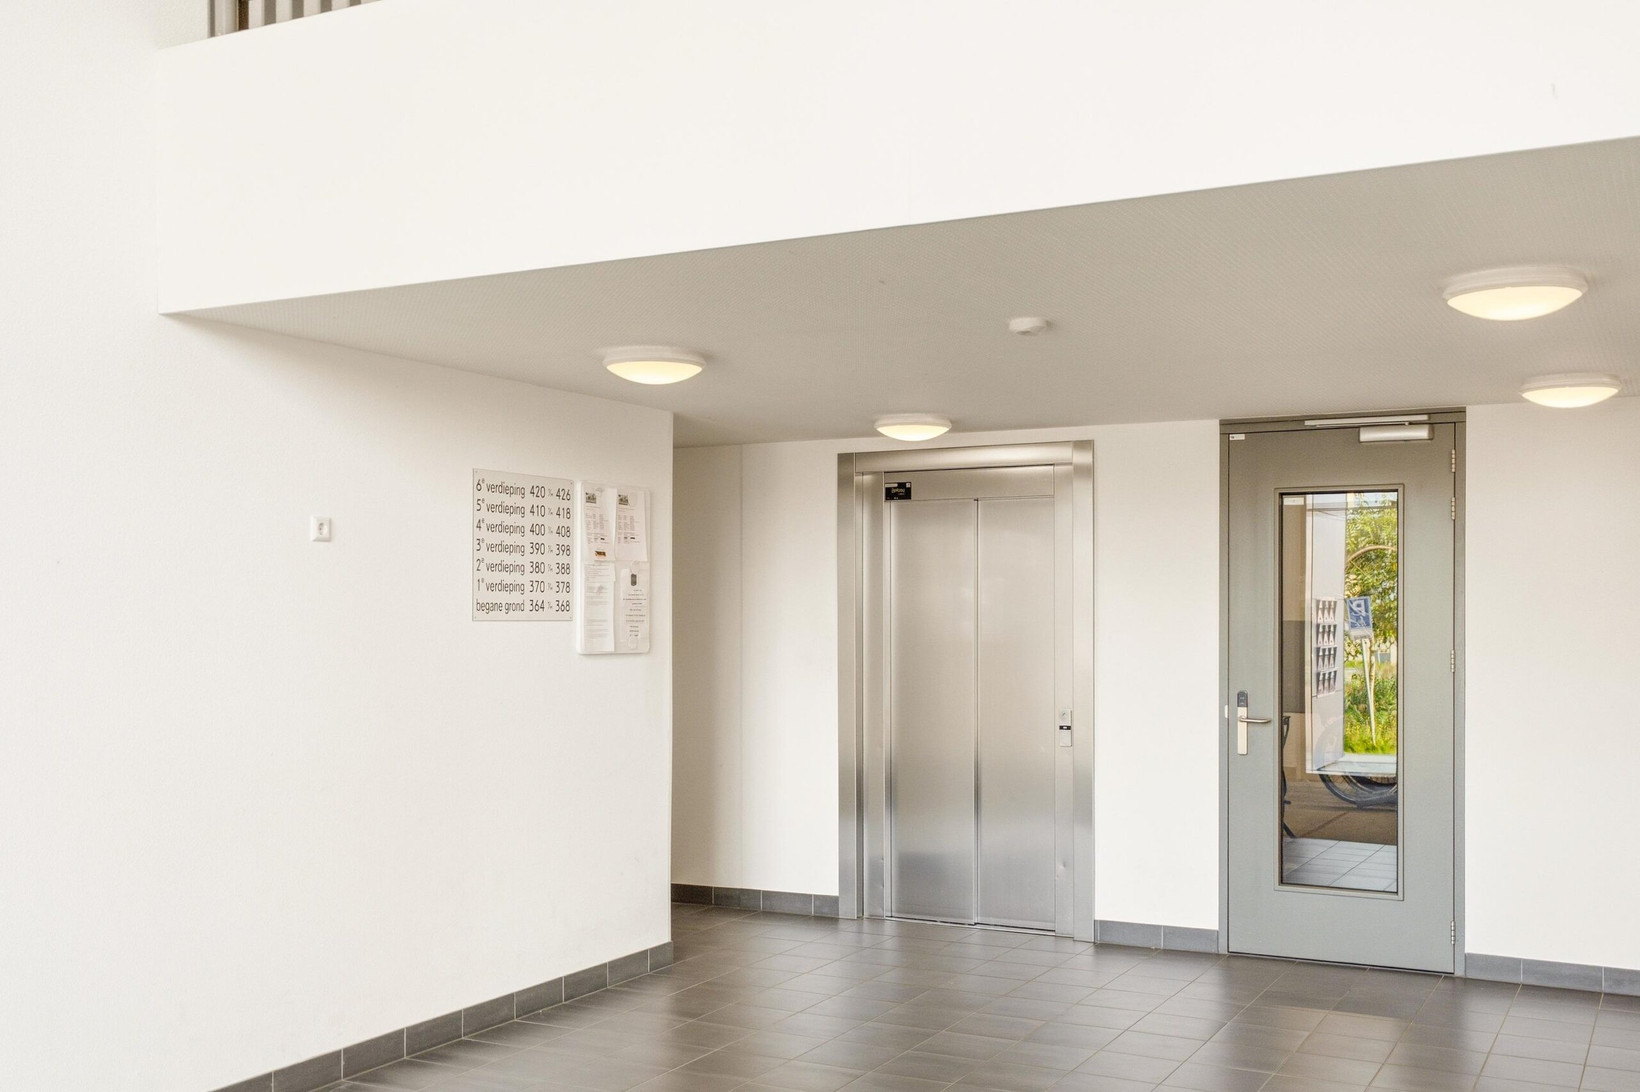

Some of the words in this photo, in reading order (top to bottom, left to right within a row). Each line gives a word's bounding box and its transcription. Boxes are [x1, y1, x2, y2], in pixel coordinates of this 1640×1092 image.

[486, 481, 525, 499] verdieping
[530, 486, 545, 498] 420
[556, 488, 571, 501] 426
[486, 501, 525, 518] verdieping
[530, 504, 545, 517] 410
[556, 507, 571, 519] 418
[486, 521, 525, 537] verdieping
[530, 523, 545, 536] 400
[556, 526, 571, 538] 408
[486, 541, 525, 556] verdieping
[530, 542, 545, 555] 390
[556, 544, 571, 556] 398
[486, 560, 525, 575] verdieping
[530, 561, 545, 574] 380
[556, 563, 571, 575] 388
[486, 580, 525, 595] verdieping
[530, 581, 545, 593] 370
[556, 582, 571, 593] 378
[476, 599, 503, 614] begane
[505, 600, 524, 614] grond
[530, 600, 545, 612] 364
[556, 600, 571, 612] 368
